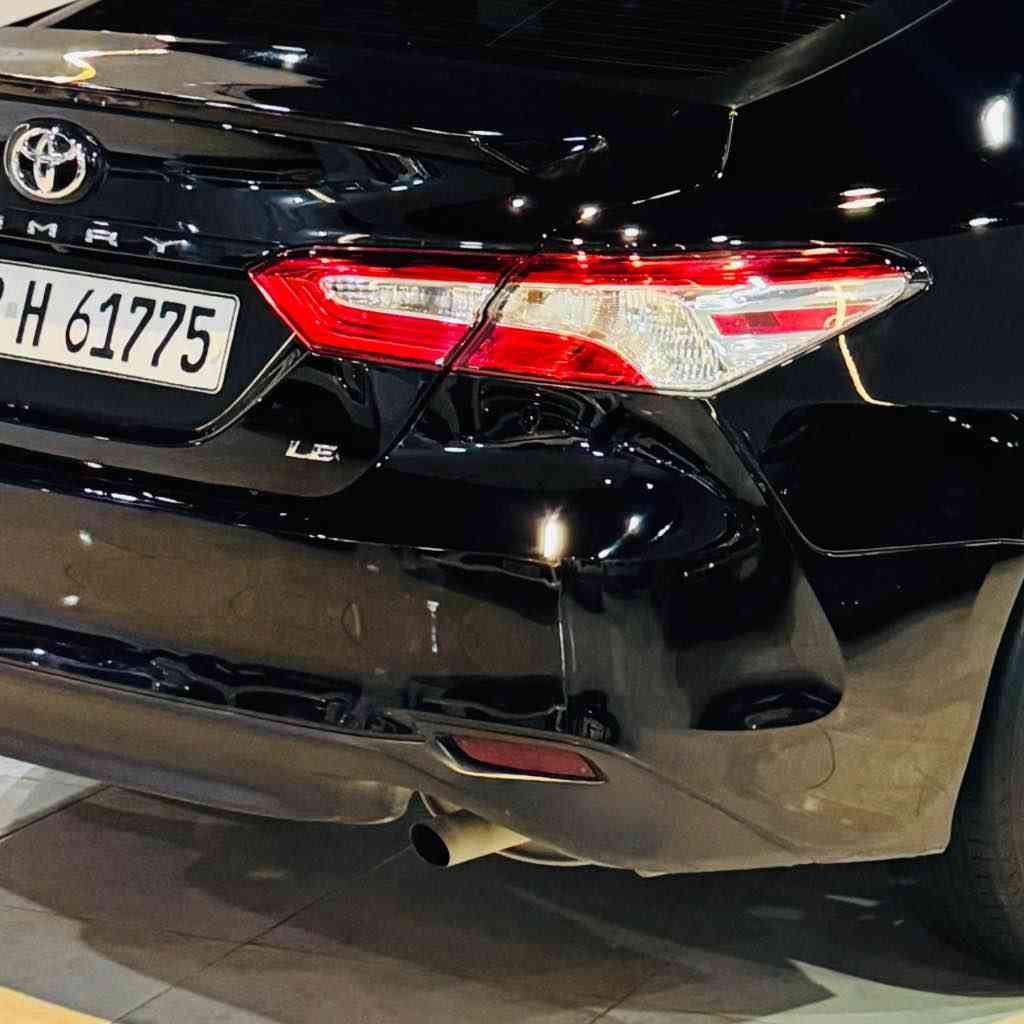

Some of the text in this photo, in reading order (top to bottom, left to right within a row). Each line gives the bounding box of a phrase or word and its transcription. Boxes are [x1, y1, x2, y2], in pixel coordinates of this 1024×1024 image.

[15, 280, 216, 373] H 61775
[285, 440, 339, 462] LE
